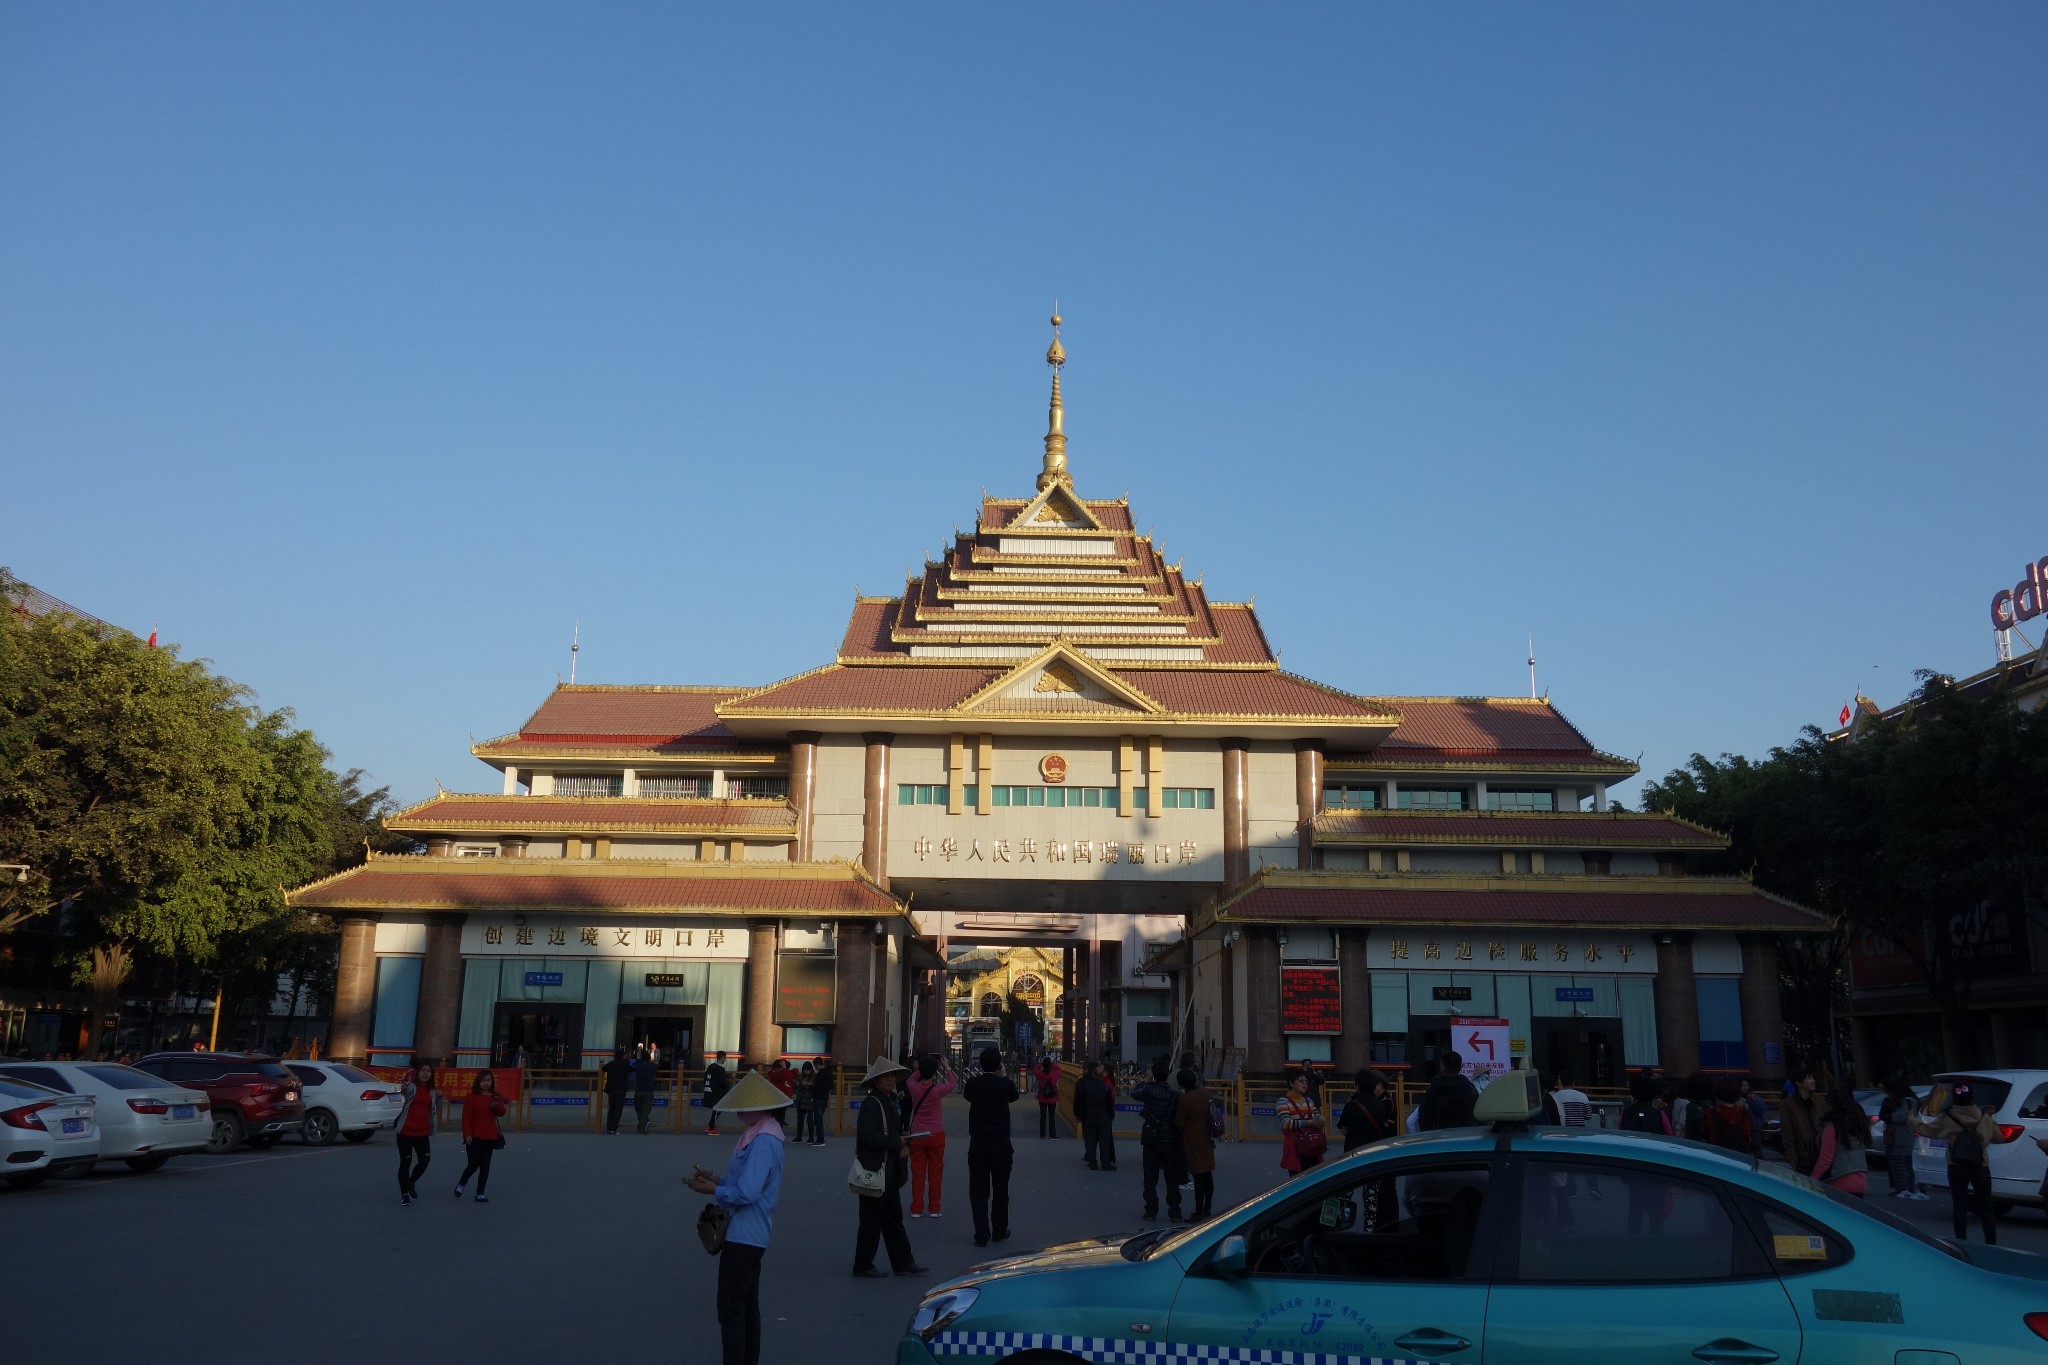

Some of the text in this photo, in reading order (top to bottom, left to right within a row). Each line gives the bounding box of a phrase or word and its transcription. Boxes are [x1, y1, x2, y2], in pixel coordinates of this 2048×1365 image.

[914, 836, 1198, 865] 中华人民共和国瑞丽口岸
[485, 926, 725, 948] 创建边境文明口岸
[1390, 940, 1635, 964] 提高边检服务水平
